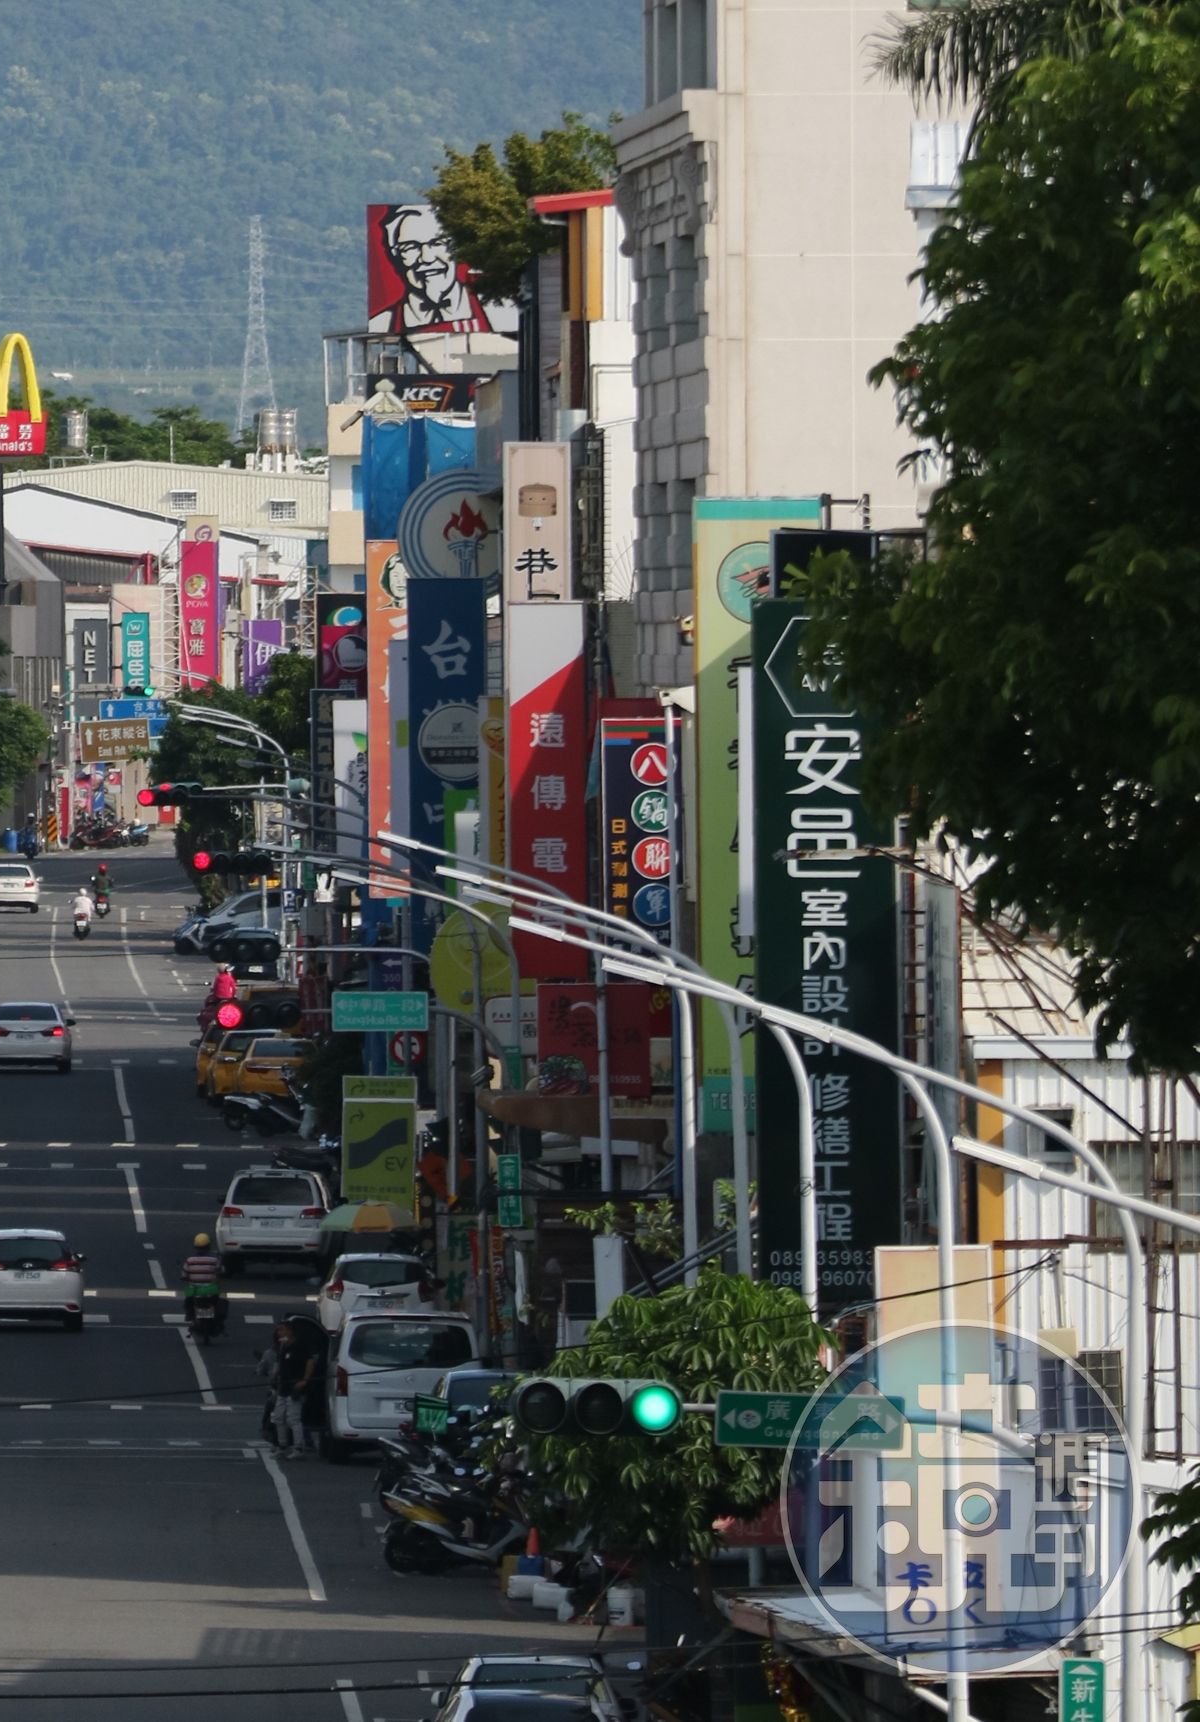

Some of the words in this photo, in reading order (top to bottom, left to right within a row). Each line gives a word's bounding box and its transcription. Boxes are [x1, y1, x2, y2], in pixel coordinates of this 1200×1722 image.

[402, 387, 443, 401] KFC
[189, 618, 206, 656] 寶雅
[83, 631, 97, 683] NET
[97, 726, 147, 742] 花東縱谷
[284, 891, 295, 907] P
[801, 888, 849, 1057] 室內設計
[343, 999, 416, 1012] 中華路一段
[384, 1156, 407, 1171] EV
[808, 1074, 852, 1241] 修繕工程
[766, 1400, 881, 1422] 廣東路
